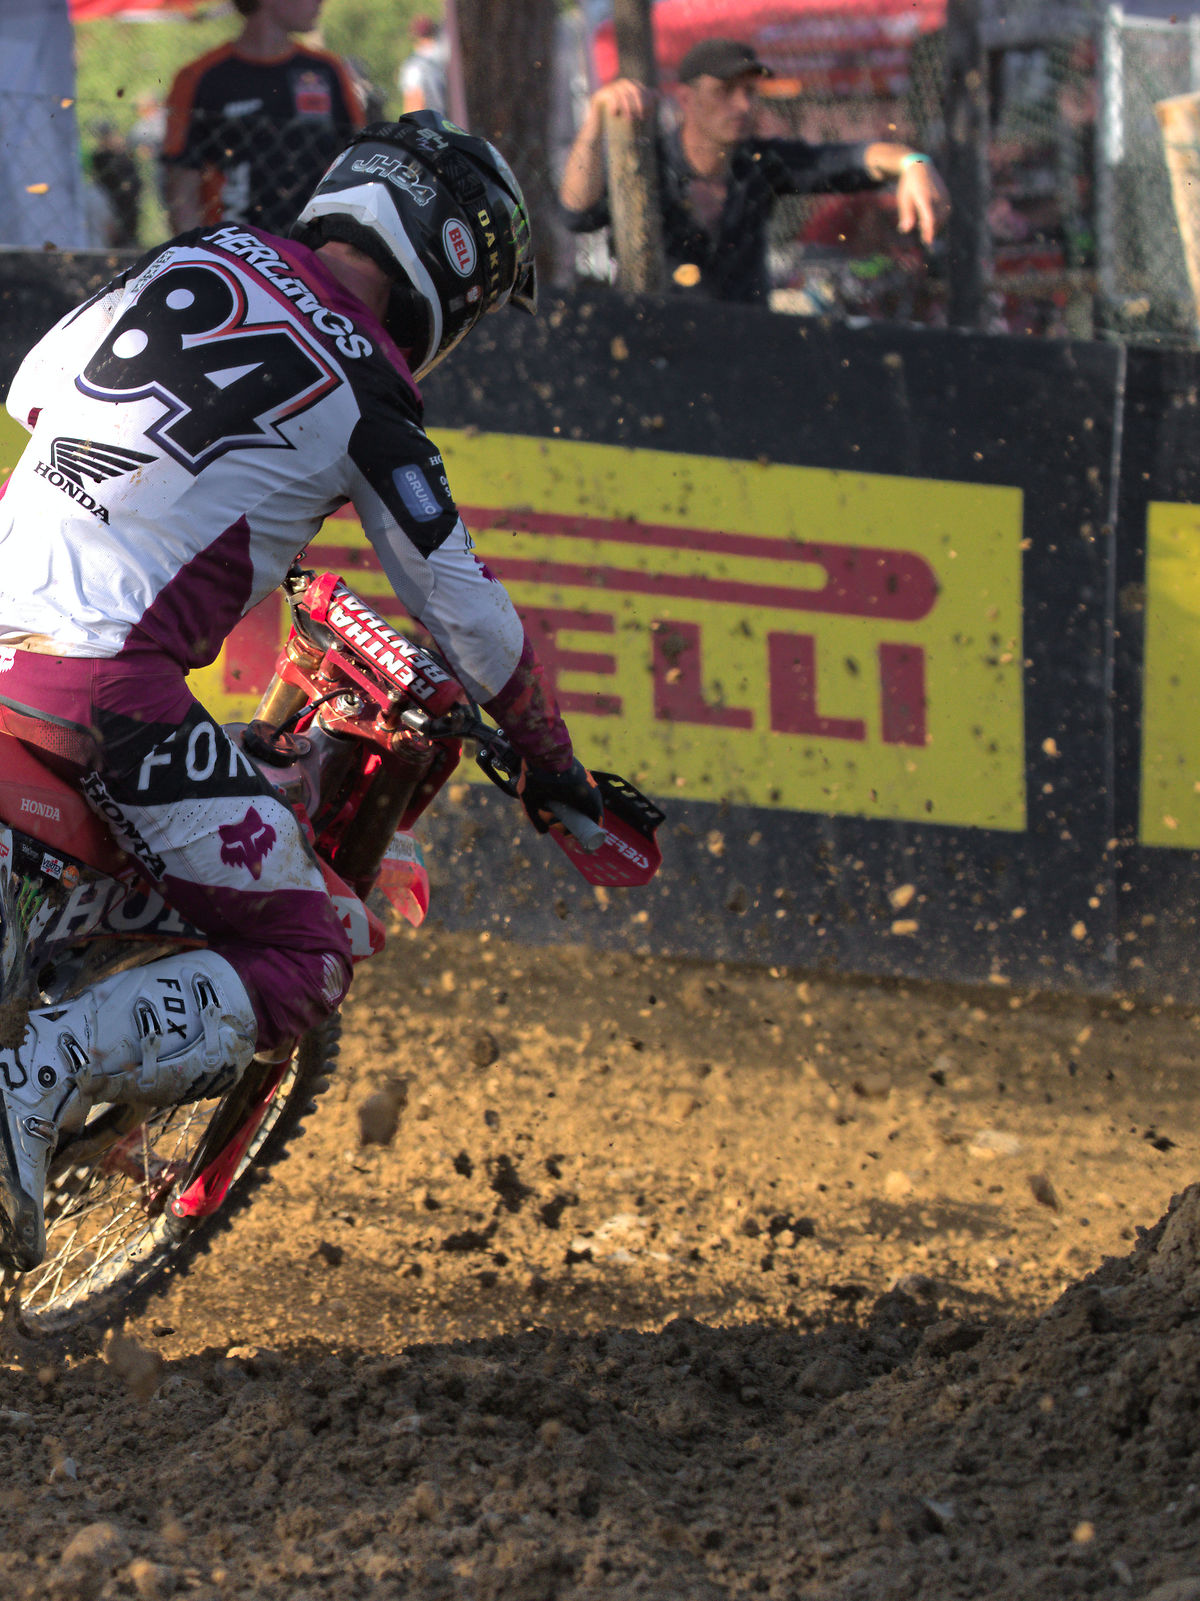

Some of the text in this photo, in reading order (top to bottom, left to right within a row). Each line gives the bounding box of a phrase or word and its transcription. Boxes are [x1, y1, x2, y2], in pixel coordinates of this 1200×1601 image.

[351, 153, 437, 207] JH84
[448, 227, 471, 270] BELL
[202, 226, 373, 359] HERLINGS
[75, 260, 345, 476] 84
[34, 460, 111, 526] HONDA
[223, 500, 939, 747] PELLI
[326, 602, 437, 701] RENTHA
[19, 798, 62, 822] HONDA
[42, 858, 62, 874] VERTEX
[156, 978, 188, 1040] FOX
